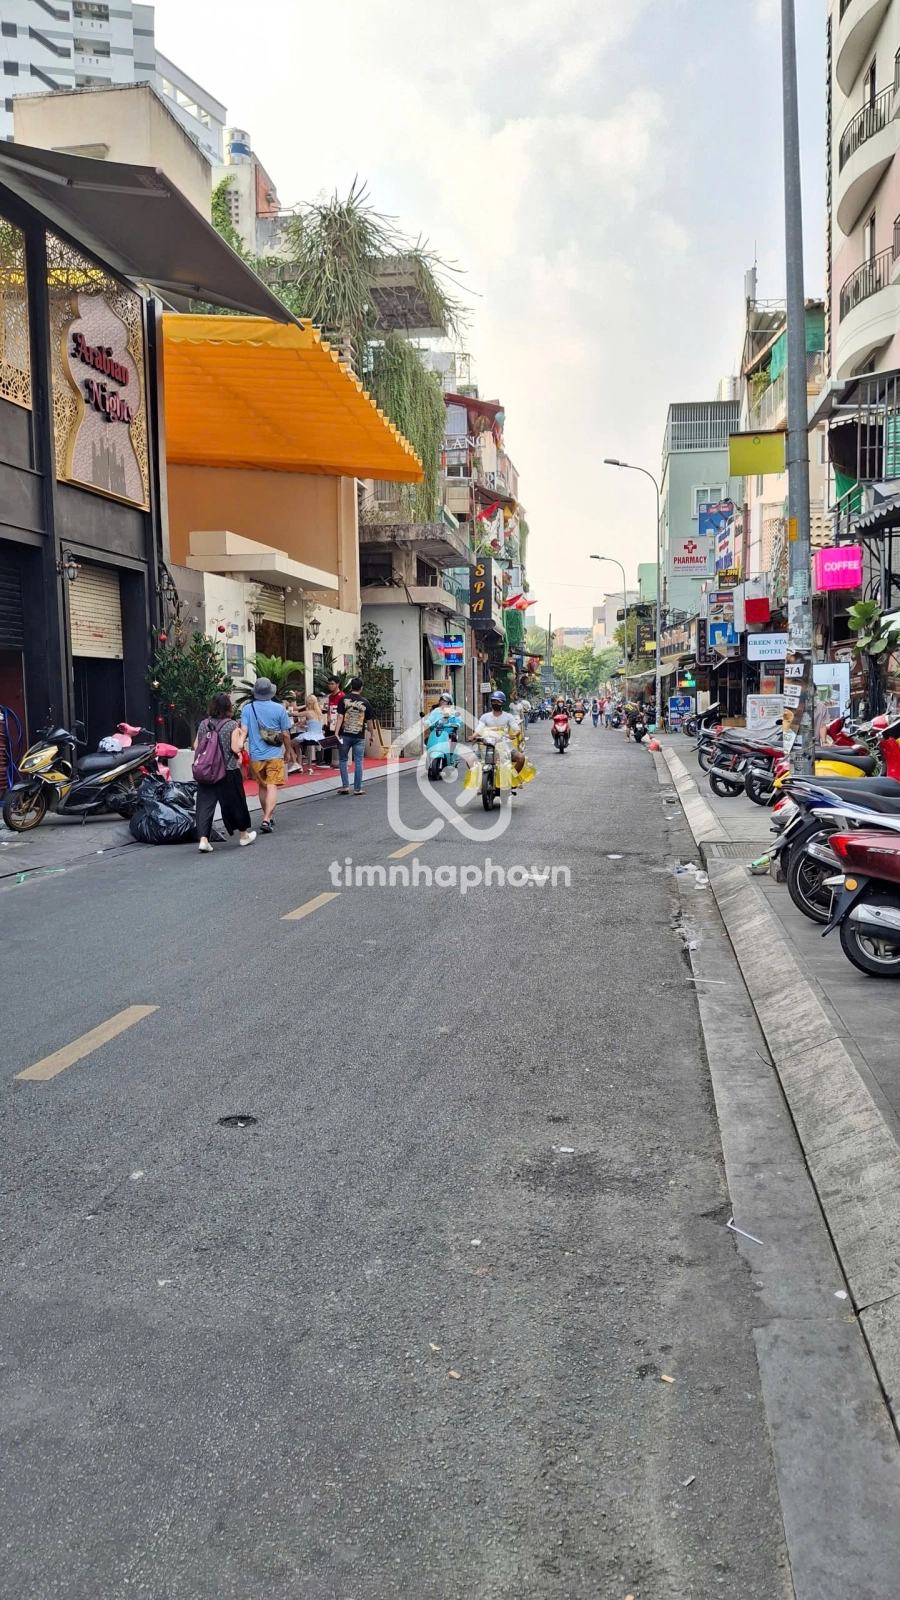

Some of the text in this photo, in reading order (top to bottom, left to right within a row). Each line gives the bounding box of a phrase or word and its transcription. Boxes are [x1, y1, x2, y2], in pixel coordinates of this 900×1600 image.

[71, 332, 129, 386] Arabian
[85, 378, 134, 423] Nights
[673, 556, 707, 565] PHARMACY
[824, 560, 860, 572] COFFEE
[471, 563, 486, 613] SPA
[785, 666, 801, 675] STA
